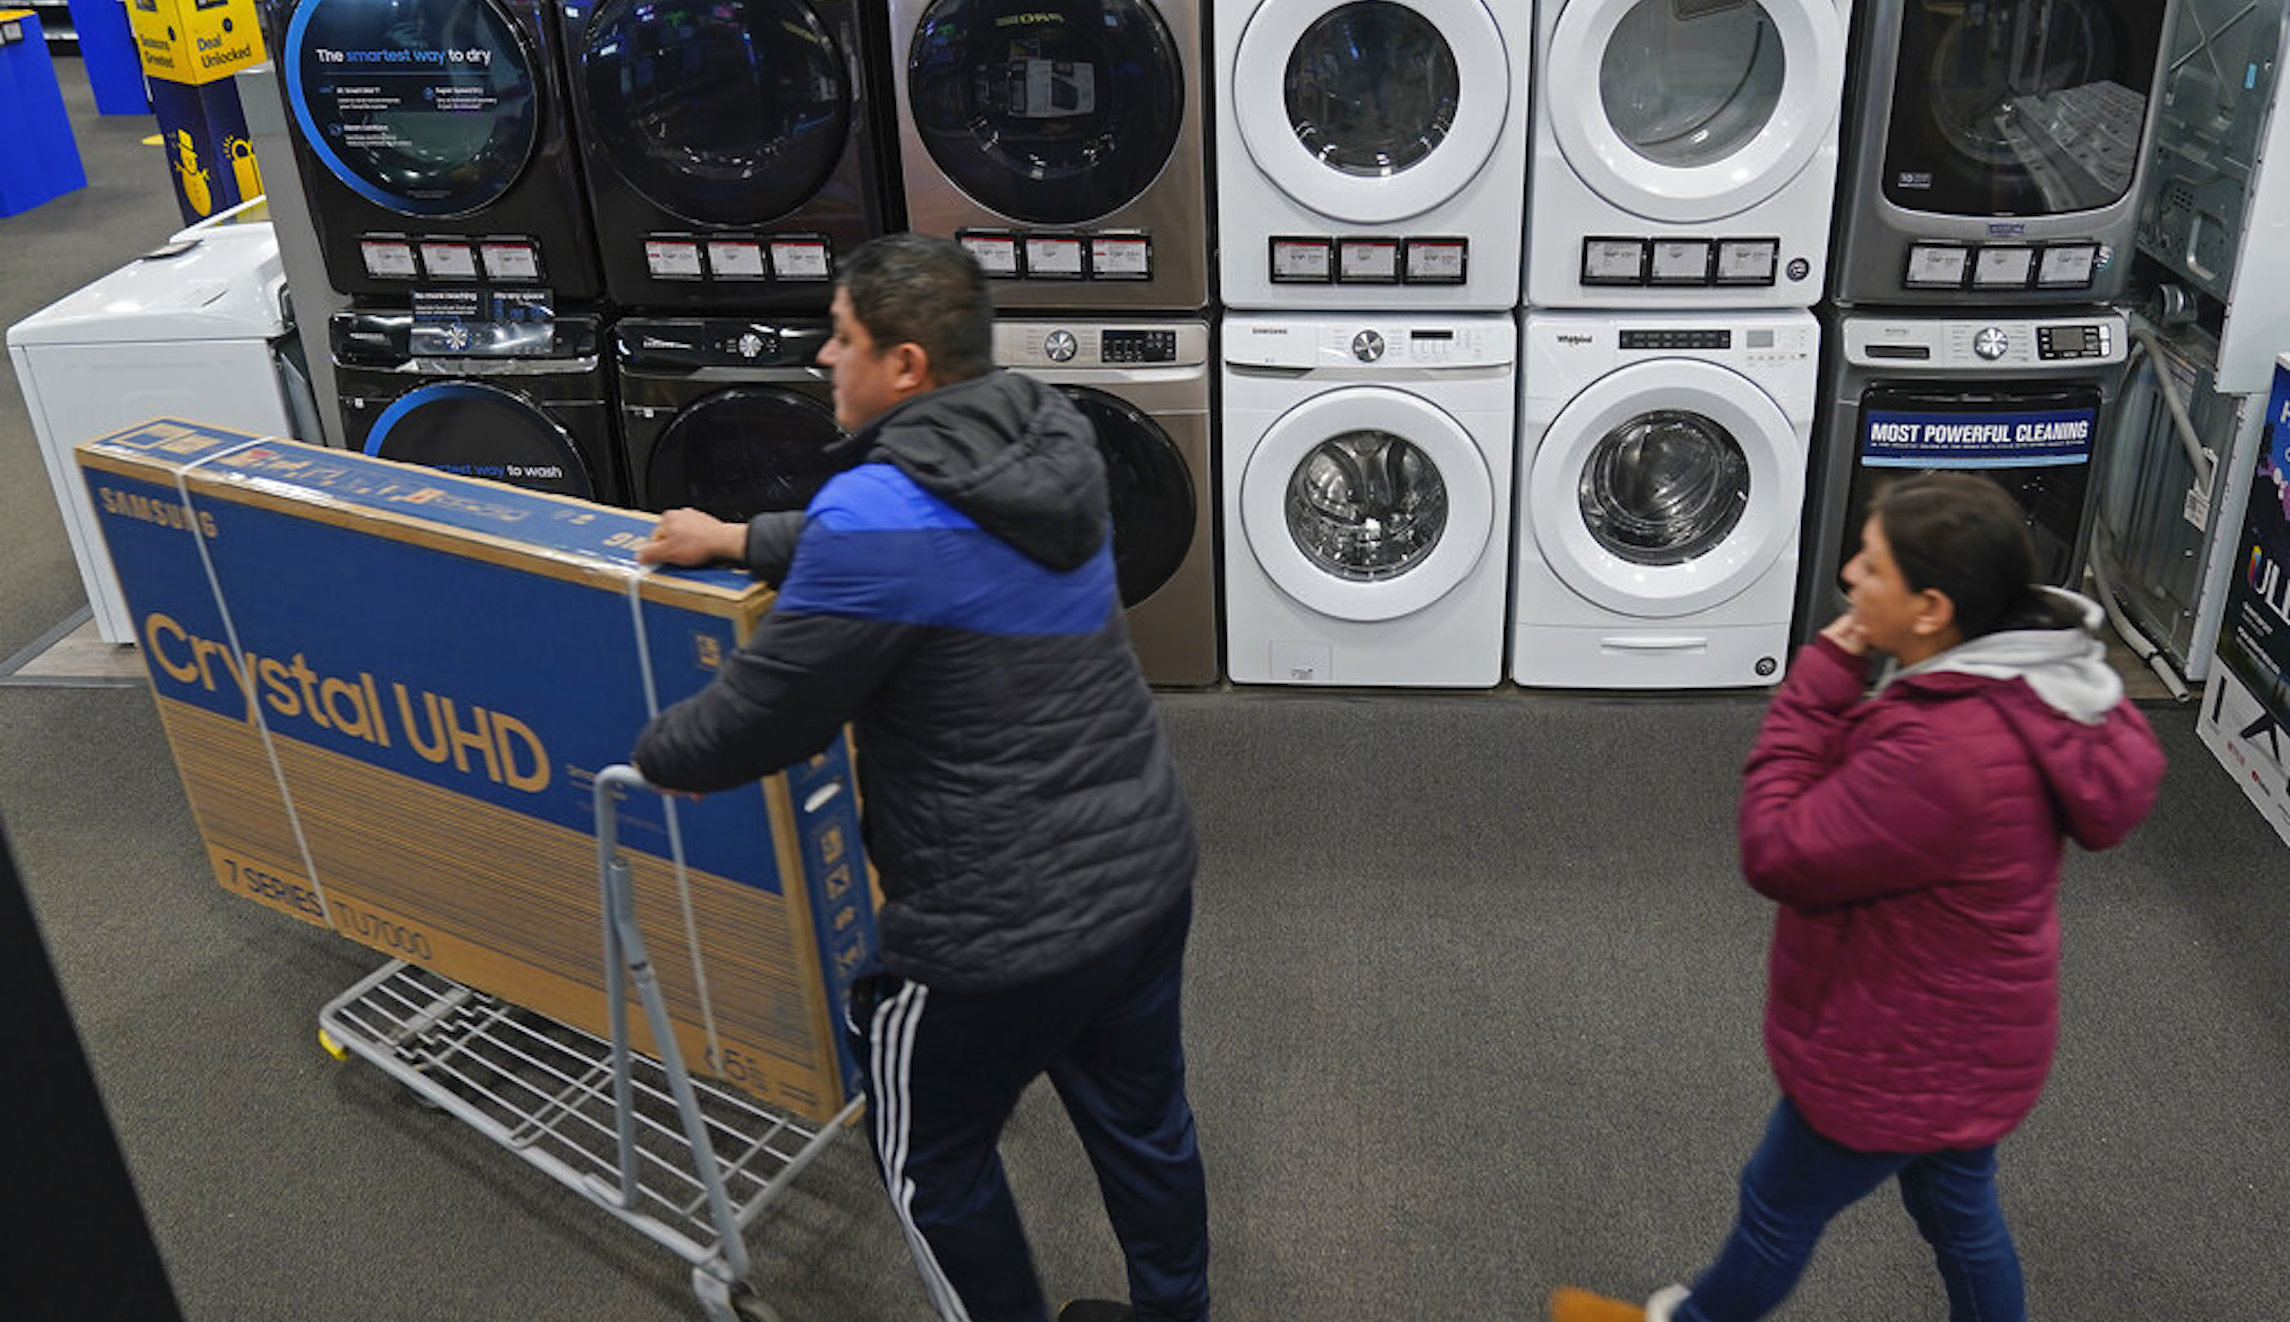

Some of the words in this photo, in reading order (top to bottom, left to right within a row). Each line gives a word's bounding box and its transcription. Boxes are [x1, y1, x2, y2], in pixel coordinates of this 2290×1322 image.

[197, 34, 222, 51] Deal
[201, 43, 251, 68] Unlocked
[317, 49, 344, 62] The
[346, 49, 412, 62] smartest
[413, 51, 446, 65] way
[448, 49, 463, 62] to
[466, 49, 491, 65] dry
[1870, 423, 1921, 443] MOST
[1924, 423, 2011, 444] POWERFUL
[2016, 420, 2090, 443] CLEANING
[474, 465, 504, 479] way
[506, 464, 522, 477] to
[523, 464, 562, 479] wash
[145, 612, 391, 747] Crystal
[394, 682, 551, 793] UHD
[223, 858, 238, 884] 7
[243, 867, 325, 918] SERIES
[332, 900, 433, 961] TU7000
